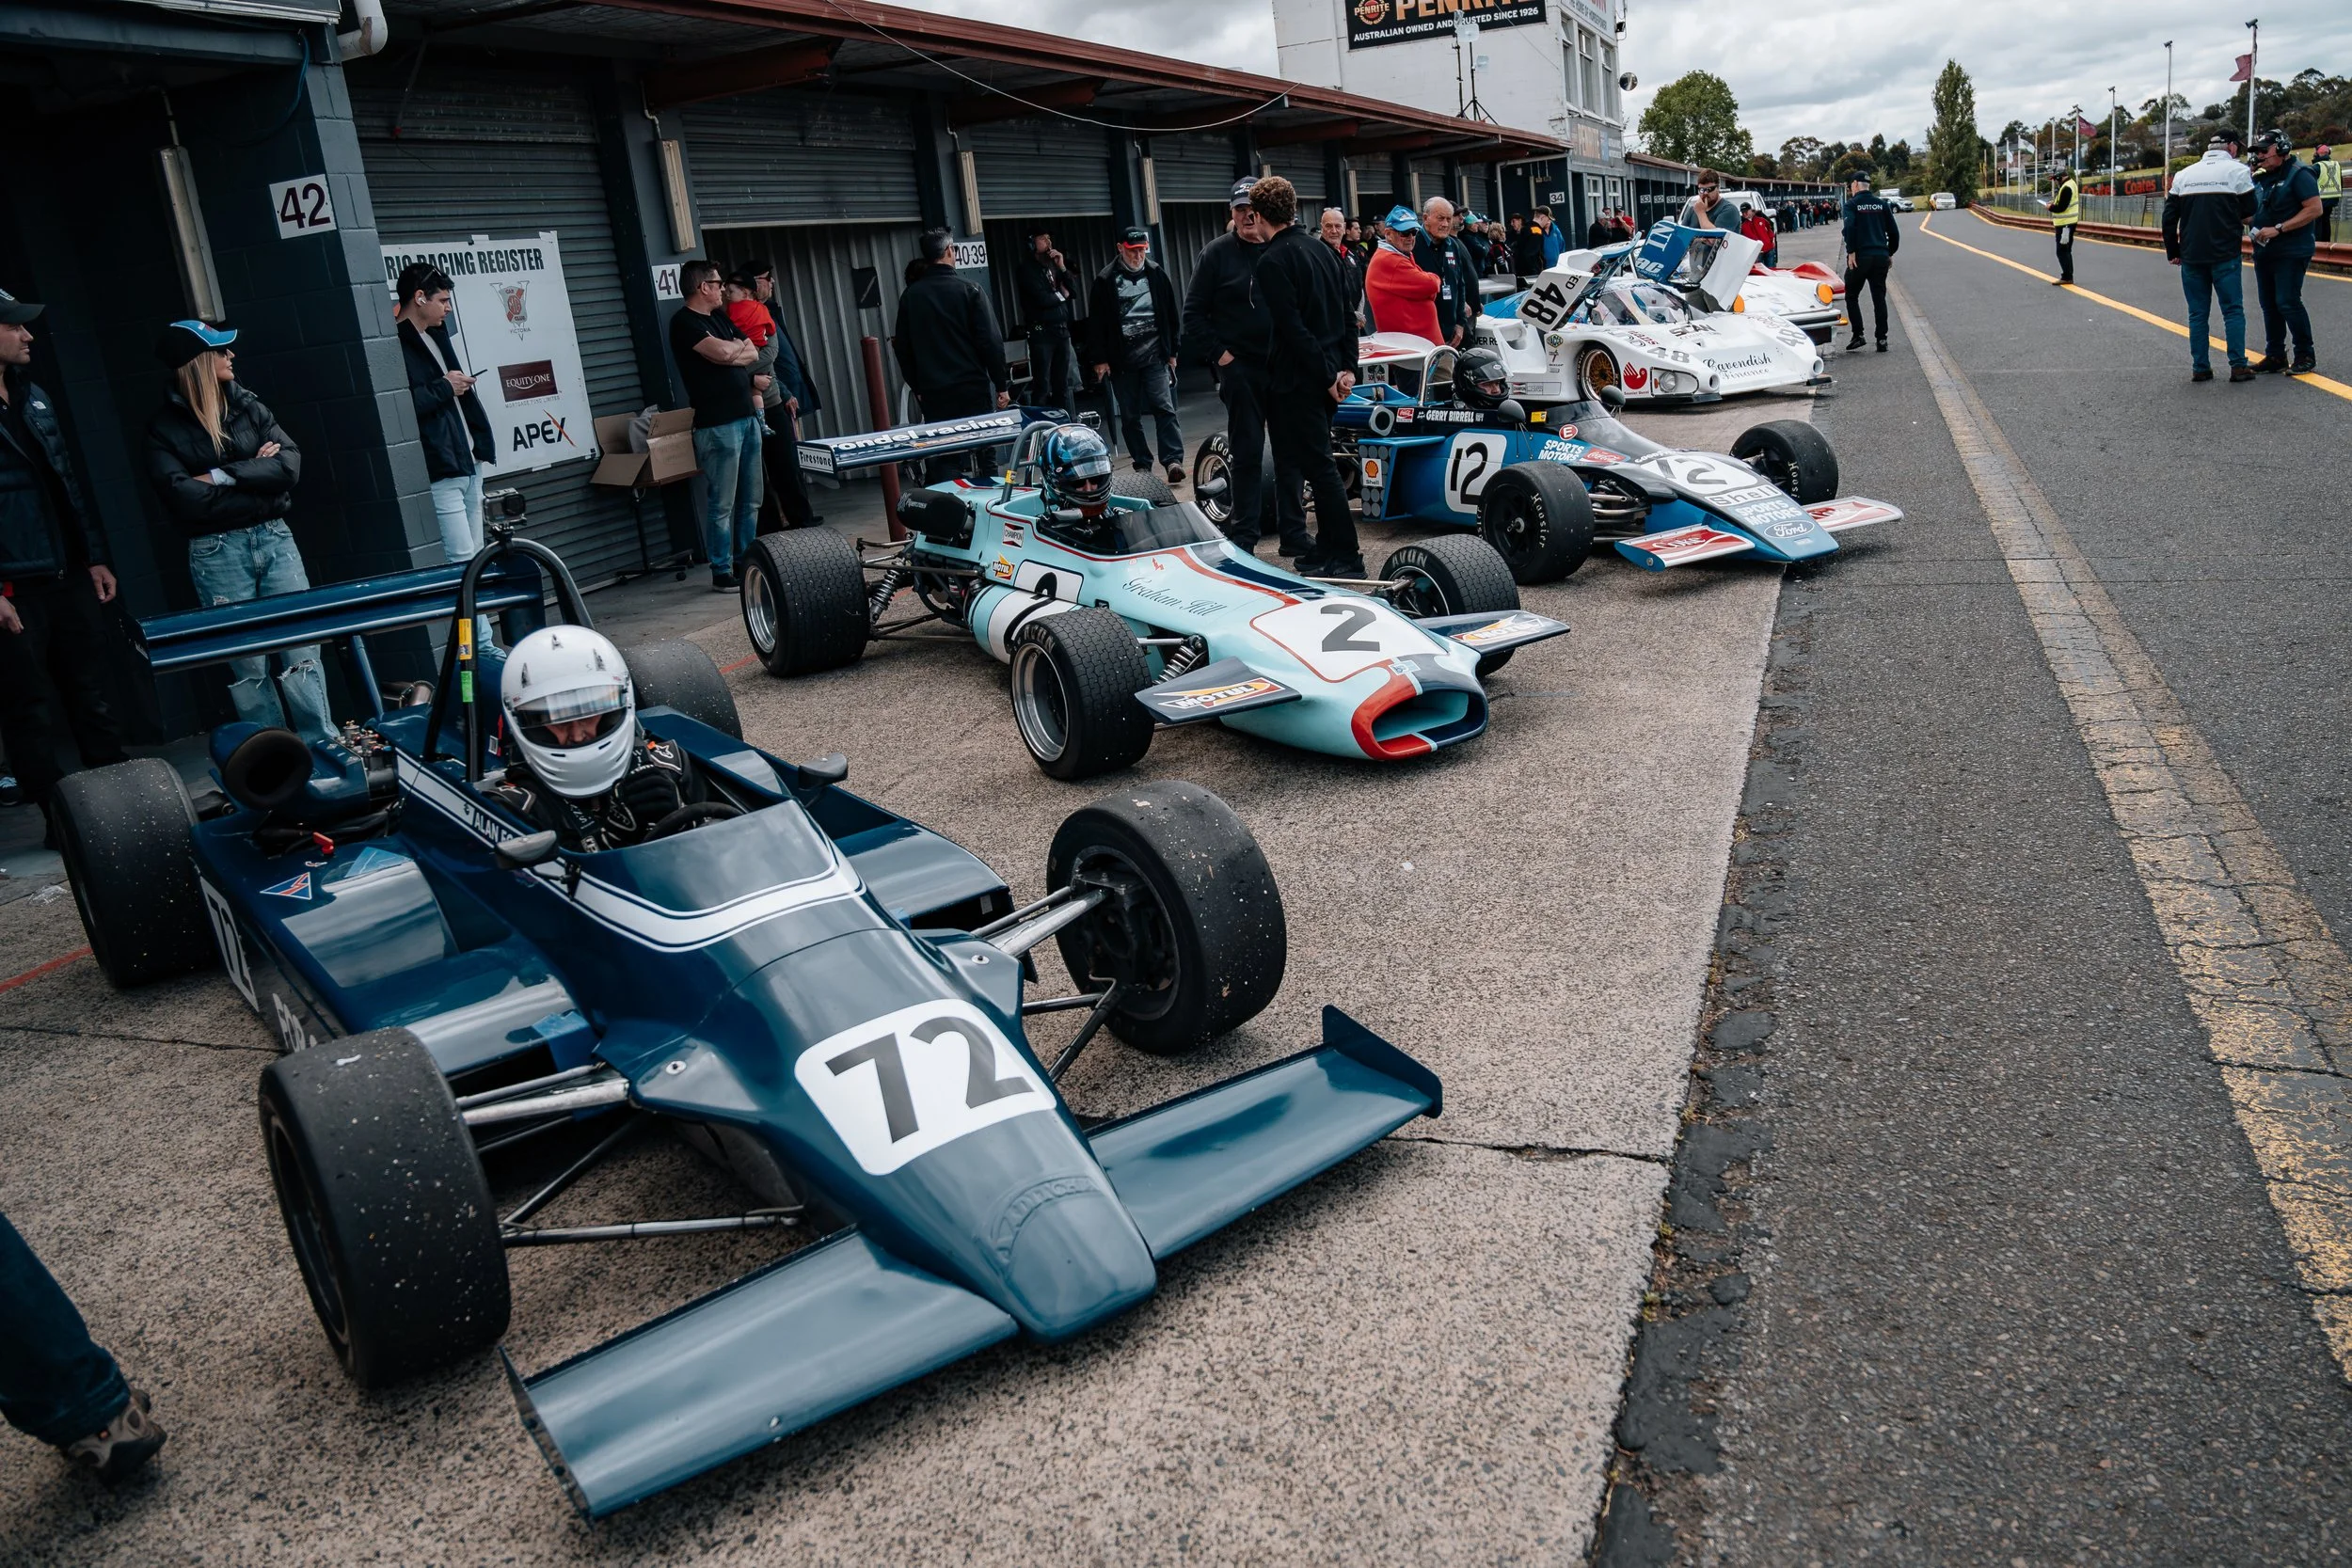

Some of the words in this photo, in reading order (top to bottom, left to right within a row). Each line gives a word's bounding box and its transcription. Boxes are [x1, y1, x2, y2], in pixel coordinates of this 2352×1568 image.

[1354, 26, 1405, 41] AUSTRALIAN
[1406, 23, 1434, 34] OWNED
[1436, 20, 1454, 29] AND
[1454, 14, 1492, 26] RUSTED
[1493, 11, 1518, 21] SINCE
[1519, 7, 1539, 16] 1926
[2124, 179, 2156, 195] Coates
[280, 183, 331, 229] 42
[1550, 194, 1564, 203] 34
[476, 247, 544, 275] REGISTER
[971, 245, 986, 264] 39
[659, 269, 679, 294] 41
[1520, 282, 1566, 325] 48
[1647, 346, 1690, 363] 48
[1703, 353, 1772, 372] Cavendish
[1426, 409, 1448, 421] GERRY
[1449, 410, 1474, 422] BIRRELL
[513, 410, 577, 451] APEX
[831, 430, 919, 451] rondel
[925, 416, 1015, 437] racing
[1210, 436, 1234, 463] Hoos
[1537, 450, 1580, 462] MOTORS
[1544, 439, 1584, 454] SPORTS
[800, 451, 832, 467] Firestone
[1450, 442, 1489, 505] 12
[1656, 458, 1727, 485] 12
[1788, 461, 1800, 499] Hoosi
[1708, 486, 1779, 506] Shell
[1736, 500, 1789, 516] SPORTS
[1745, 507, 1803, 526] MOTORS
[1004, 530, 1023, 541] CHAMPION
[1773, 523, 1807, 537] Ford
[1652, 536, 1706, 550] Coke
[993, 562, 1009, 574] MOTUL
[1391, 548, 1428, 567] AVON
[1122, 578, 1182, 610] Graham
[1180, 599, 1227, 616] Hill
[1320, 604, 1380, 652] 2
[1024, 624, 1056, 654] AVON
[1175, 686, 1255, 707] MOTUL
[474, 812, 499, 843] ALAN
[272, 992, 318, 1053] FOR
[825, 1016, 1035, 1144] 72
